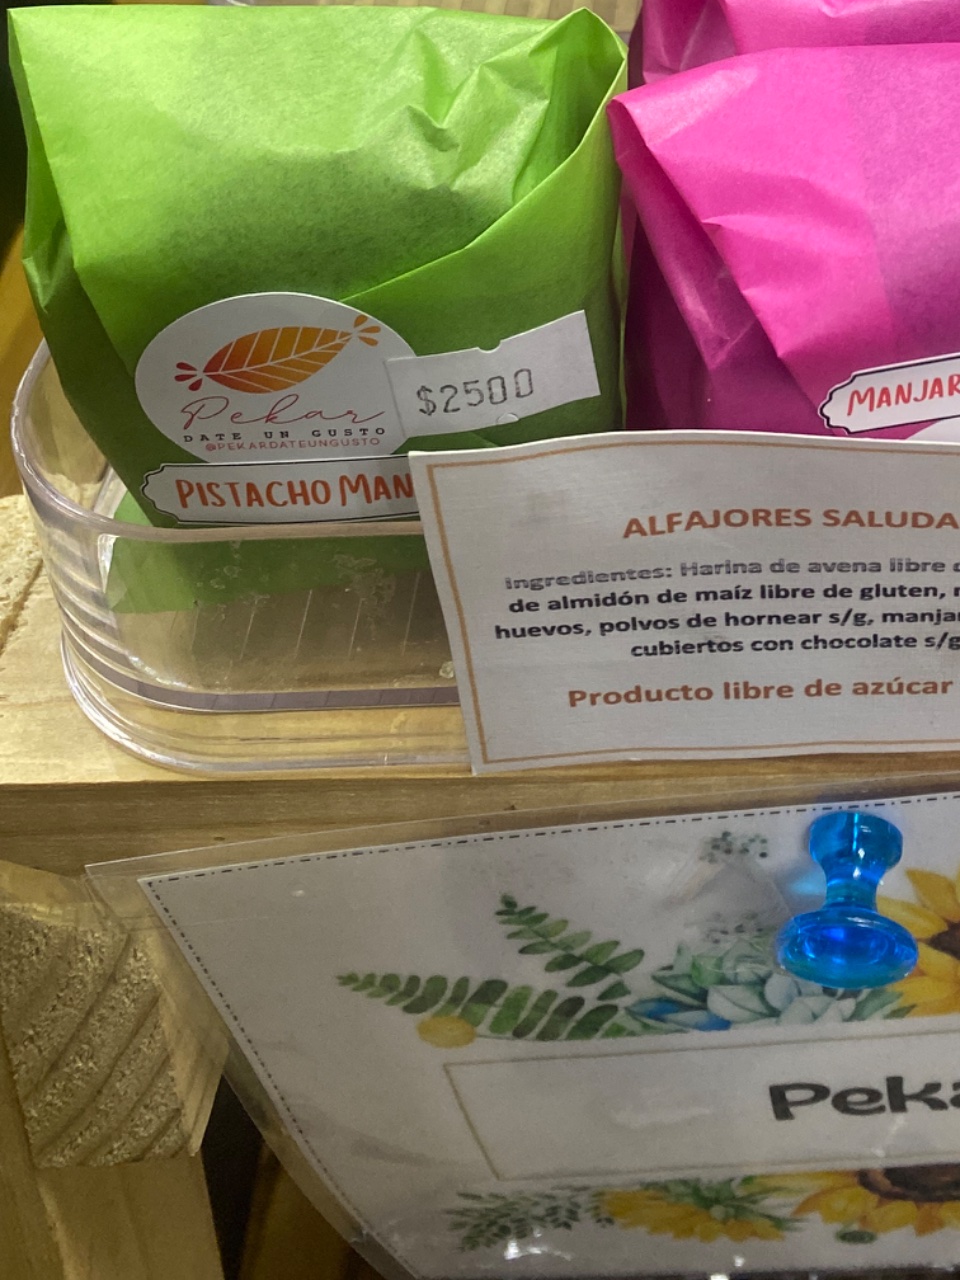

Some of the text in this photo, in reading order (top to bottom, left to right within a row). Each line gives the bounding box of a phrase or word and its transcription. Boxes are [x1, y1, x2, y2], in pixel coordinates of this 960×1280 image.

[416, 368, 534, 416] $2500
[181, 393, 386, 431] Pekar
[184, 427, 387, 443] DATE UN GUSTO
[205, 437, 381, 453] @PEKARDATEUNGUSTO
[175, 473, 414, 509] PISTACHO MAN
[622, 508, 813, 539] ALFAJORES
[769, 557, 801, 574] de
[808, 561, 882, 574] avena
[889, 558, 946, 573] libre
[508, 599, 541, 613] de
[546, 589, 650, 612] almidón
[656, 589, 688, 604] de
[695, 584, 753, 602] maíz
[759, 583, 815, 600] libre
[823, 583, 853, 599] de
[859, 582, 947, 602] gluten,
[494, 622, 592, 639] huevos,
[599, 616, 680, 636] polvos
[686, 613, 717, 629] de
[724, 610, 823, 627] hornear
[829, 608, 875, 627] s/g,
[630, 638, 744, 657] cubiertos
[750, 637, 794, 652] con
[800, 632, 918, 651] chocolate
[568, 683, 714, 707] Producto
[723, 680, 795, 701] libre
[803, 678, 842, 698] de
[852, 677, 954, 696] azúcar
